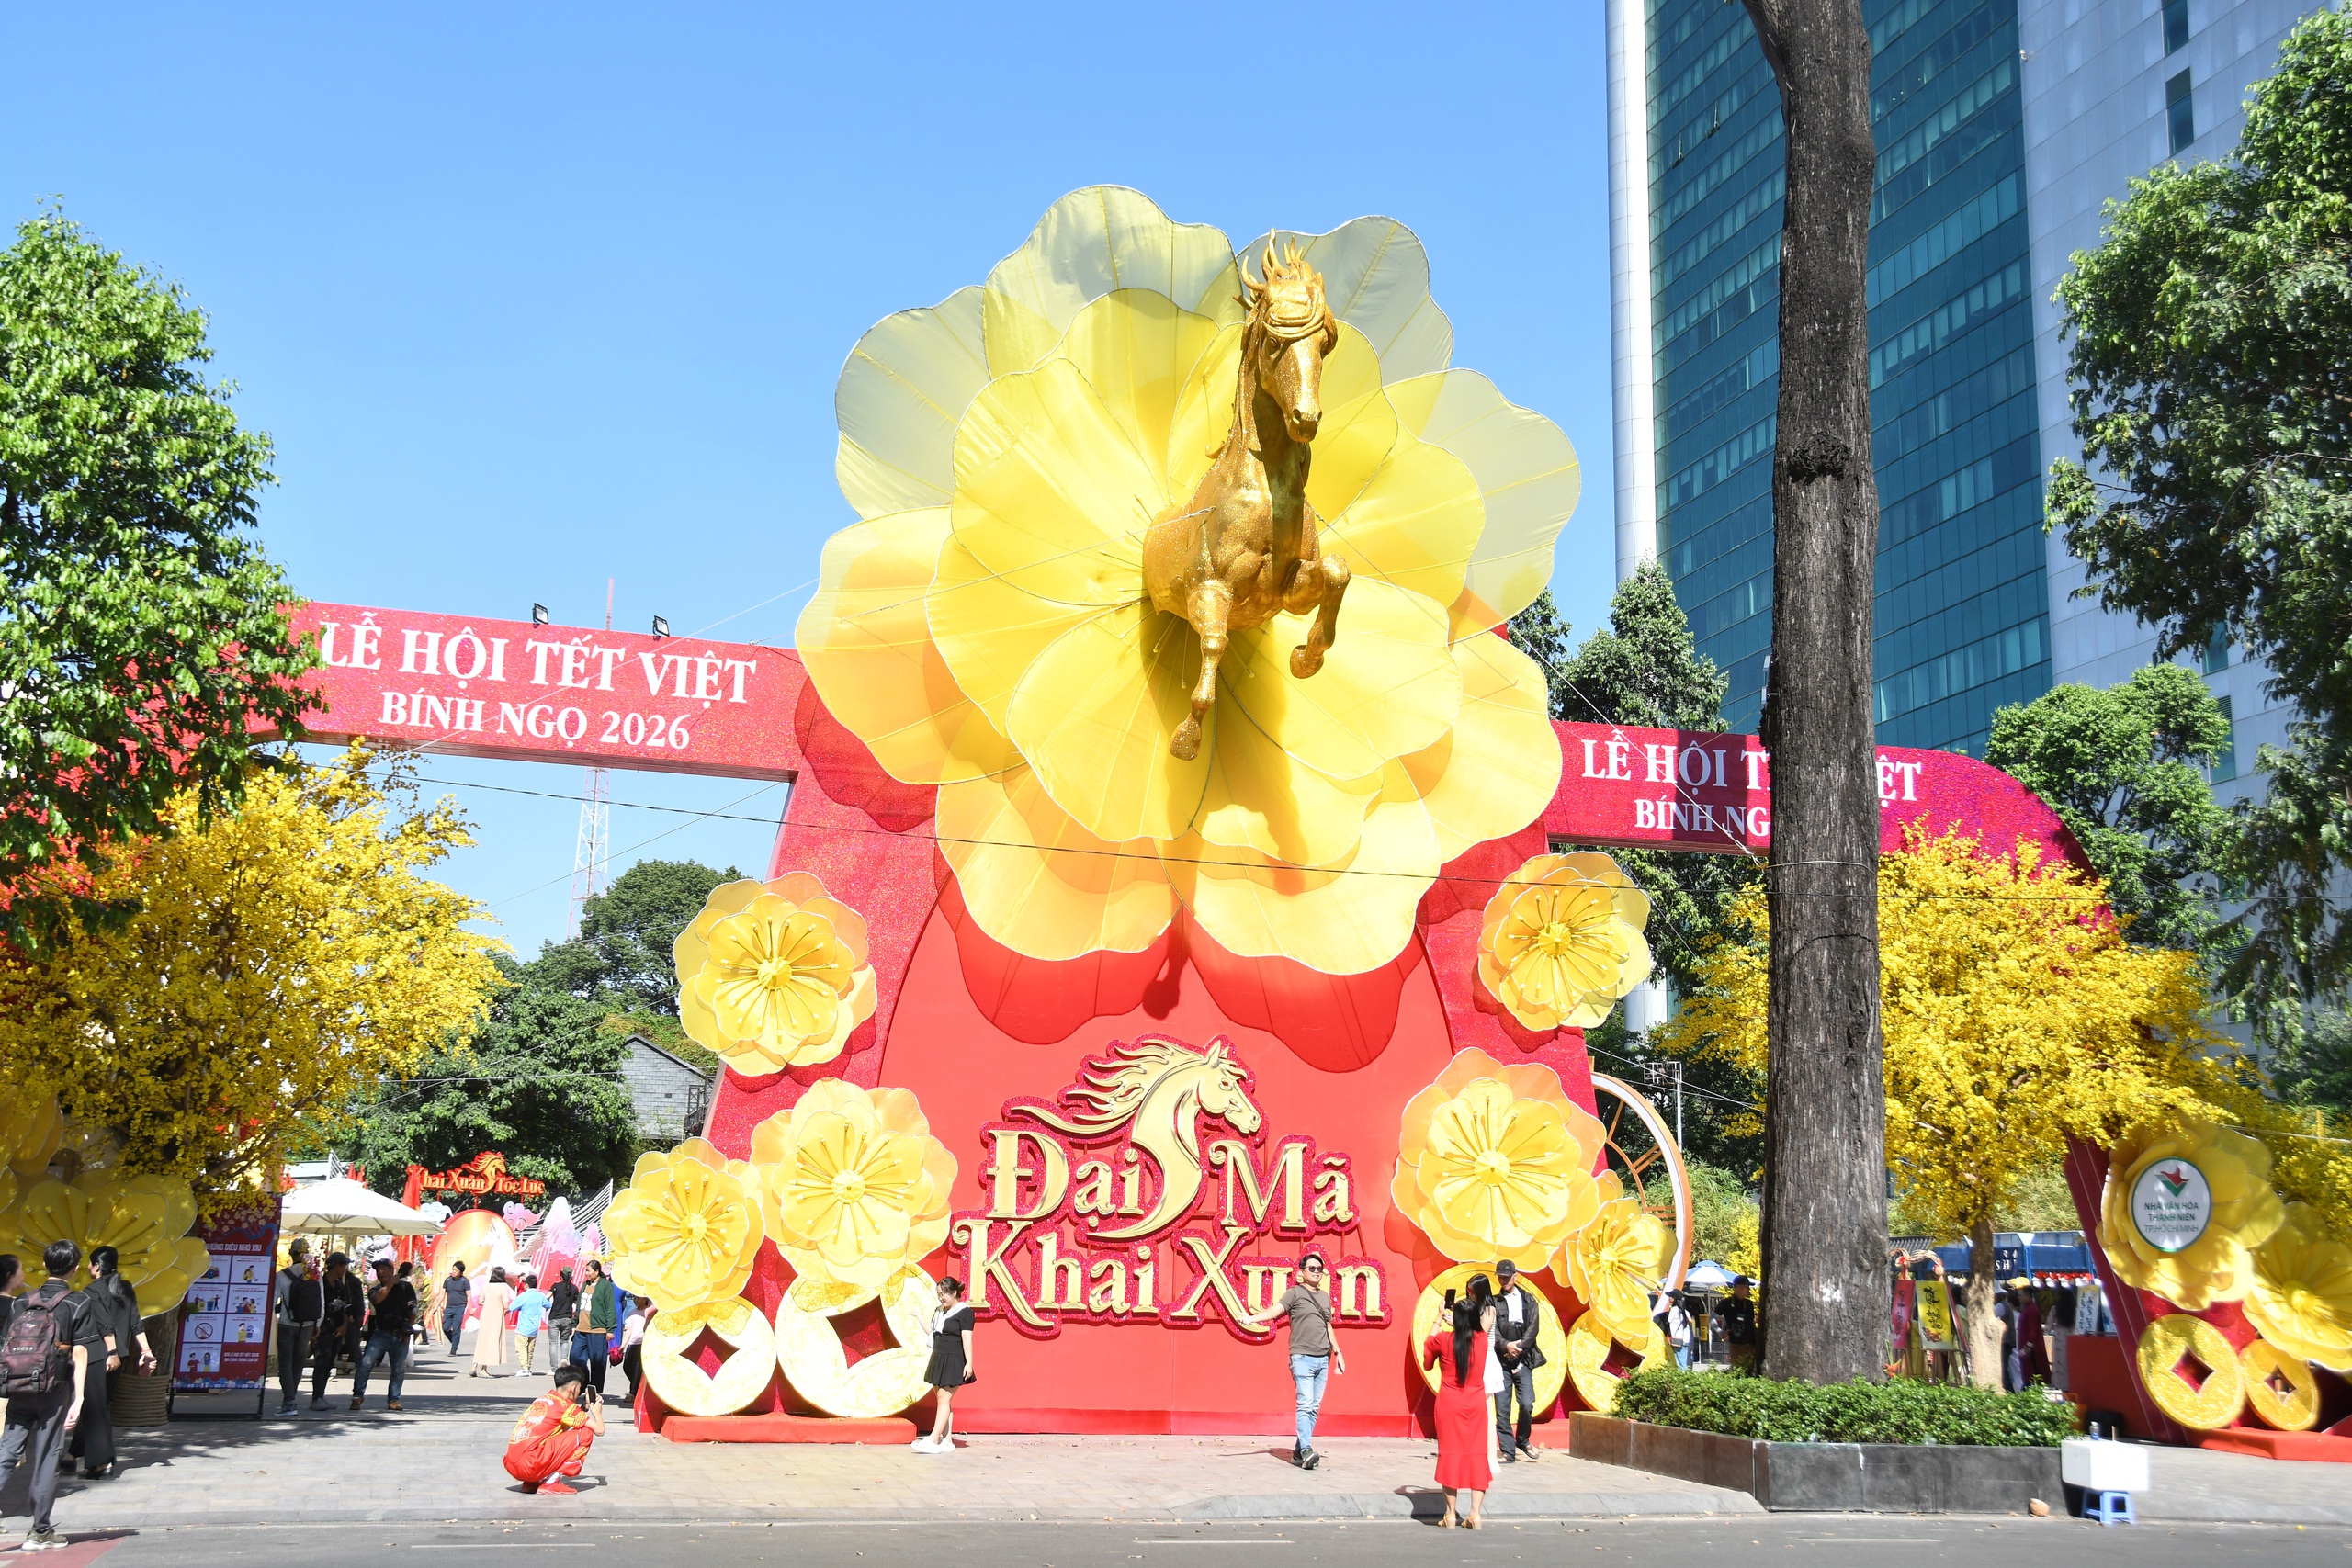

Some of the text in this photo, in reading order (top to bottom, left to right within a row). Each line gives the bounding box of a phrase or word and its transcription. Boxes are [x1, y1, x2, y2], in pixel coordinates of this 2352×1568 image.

[319, 611, 757, 709] LỄ HỘI TẾT VIỆT
[379, 687, 691, 750] BÍNH NGỌ 2026
[1581, 728, 1632, 781] LỄ
[1644, 739, 1728, 795] HỘI
[1875, 754, 1921, 807] ỆT
[1634, 795, 1770, 837] BÍNH NG
[987, 1129, 1355, 1229] Đại Mã
[952, 1218, 1385, 1334] Khai Xun
